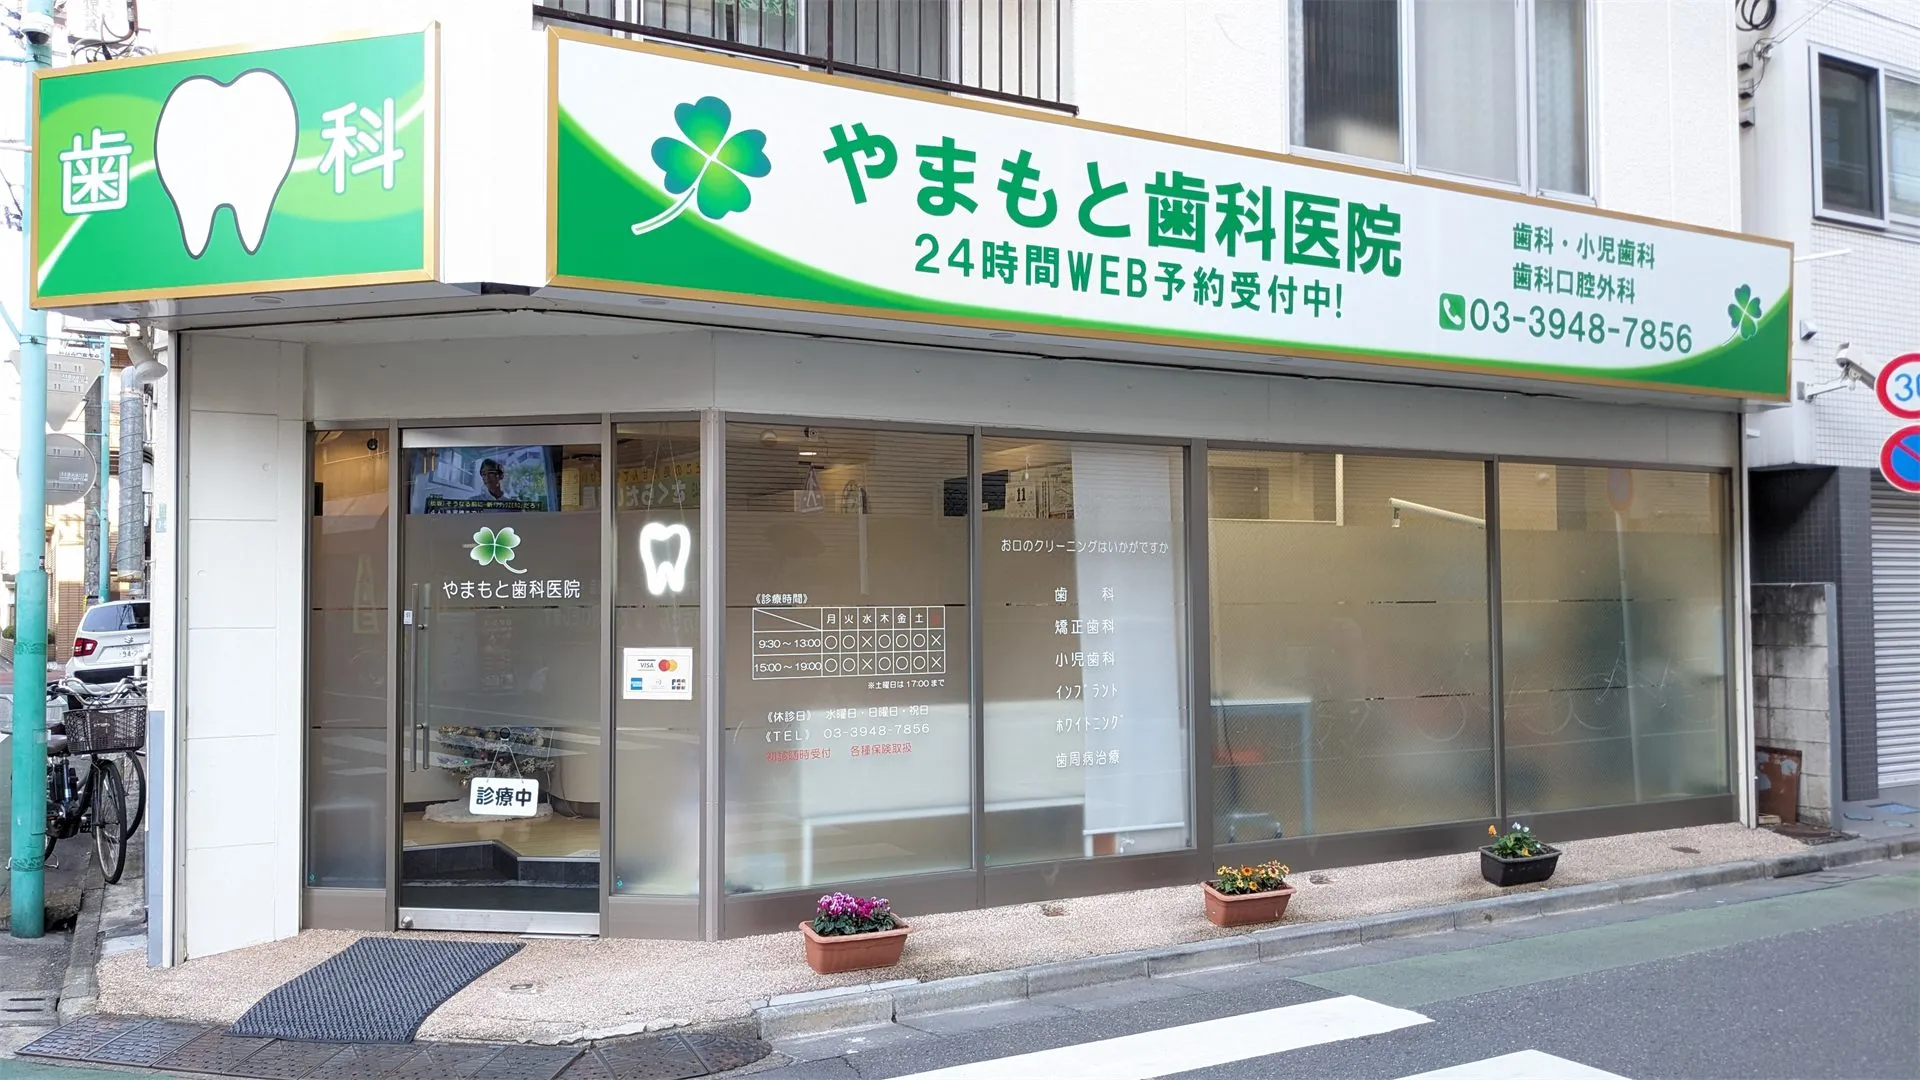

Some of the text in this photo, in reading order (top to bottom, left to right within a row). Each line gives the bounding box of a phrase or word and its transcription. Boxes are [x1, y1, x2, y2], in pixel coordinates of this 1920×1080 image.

[59, 97, 404, 215] 歯 科
[823, 122, 1402, 278] やまもと歯科医院
[1513, 222, 1655, 270] 歯科・小児歯科
[915, 233, 1343, 320] 24時間WEB予約受付中!
[1513, 262, 1635, 304] 歯科口腔外科
[1470, 299, 1692, 353] 03-3948-7856
[1894, 373, 1920, 402] 3
[1016, 487, 1026, 501] 11
[1001, 539, 1169, 554] お口のクリーニングはいかがですか
[442, 579, 581, 599] やまもと歯科医院
[826, 614, 836, 624] 月
[844, 614, 854, 624] 火
[862, 613, 872, 624] 水
[880, 613, 890, 624] 木
[897, 613, 907, 624] 金
[914, 613, 924, 623] 土
[1055, 619, 1114, 635] 矯正歯科
[1055, 651, 1115, 667] 小児歯科
[824, 723, 930, 739] 03-3948-7856
[1056, 749, 1120, 768] 歯周病治療
[476, 786, 532, 808] 診療中
